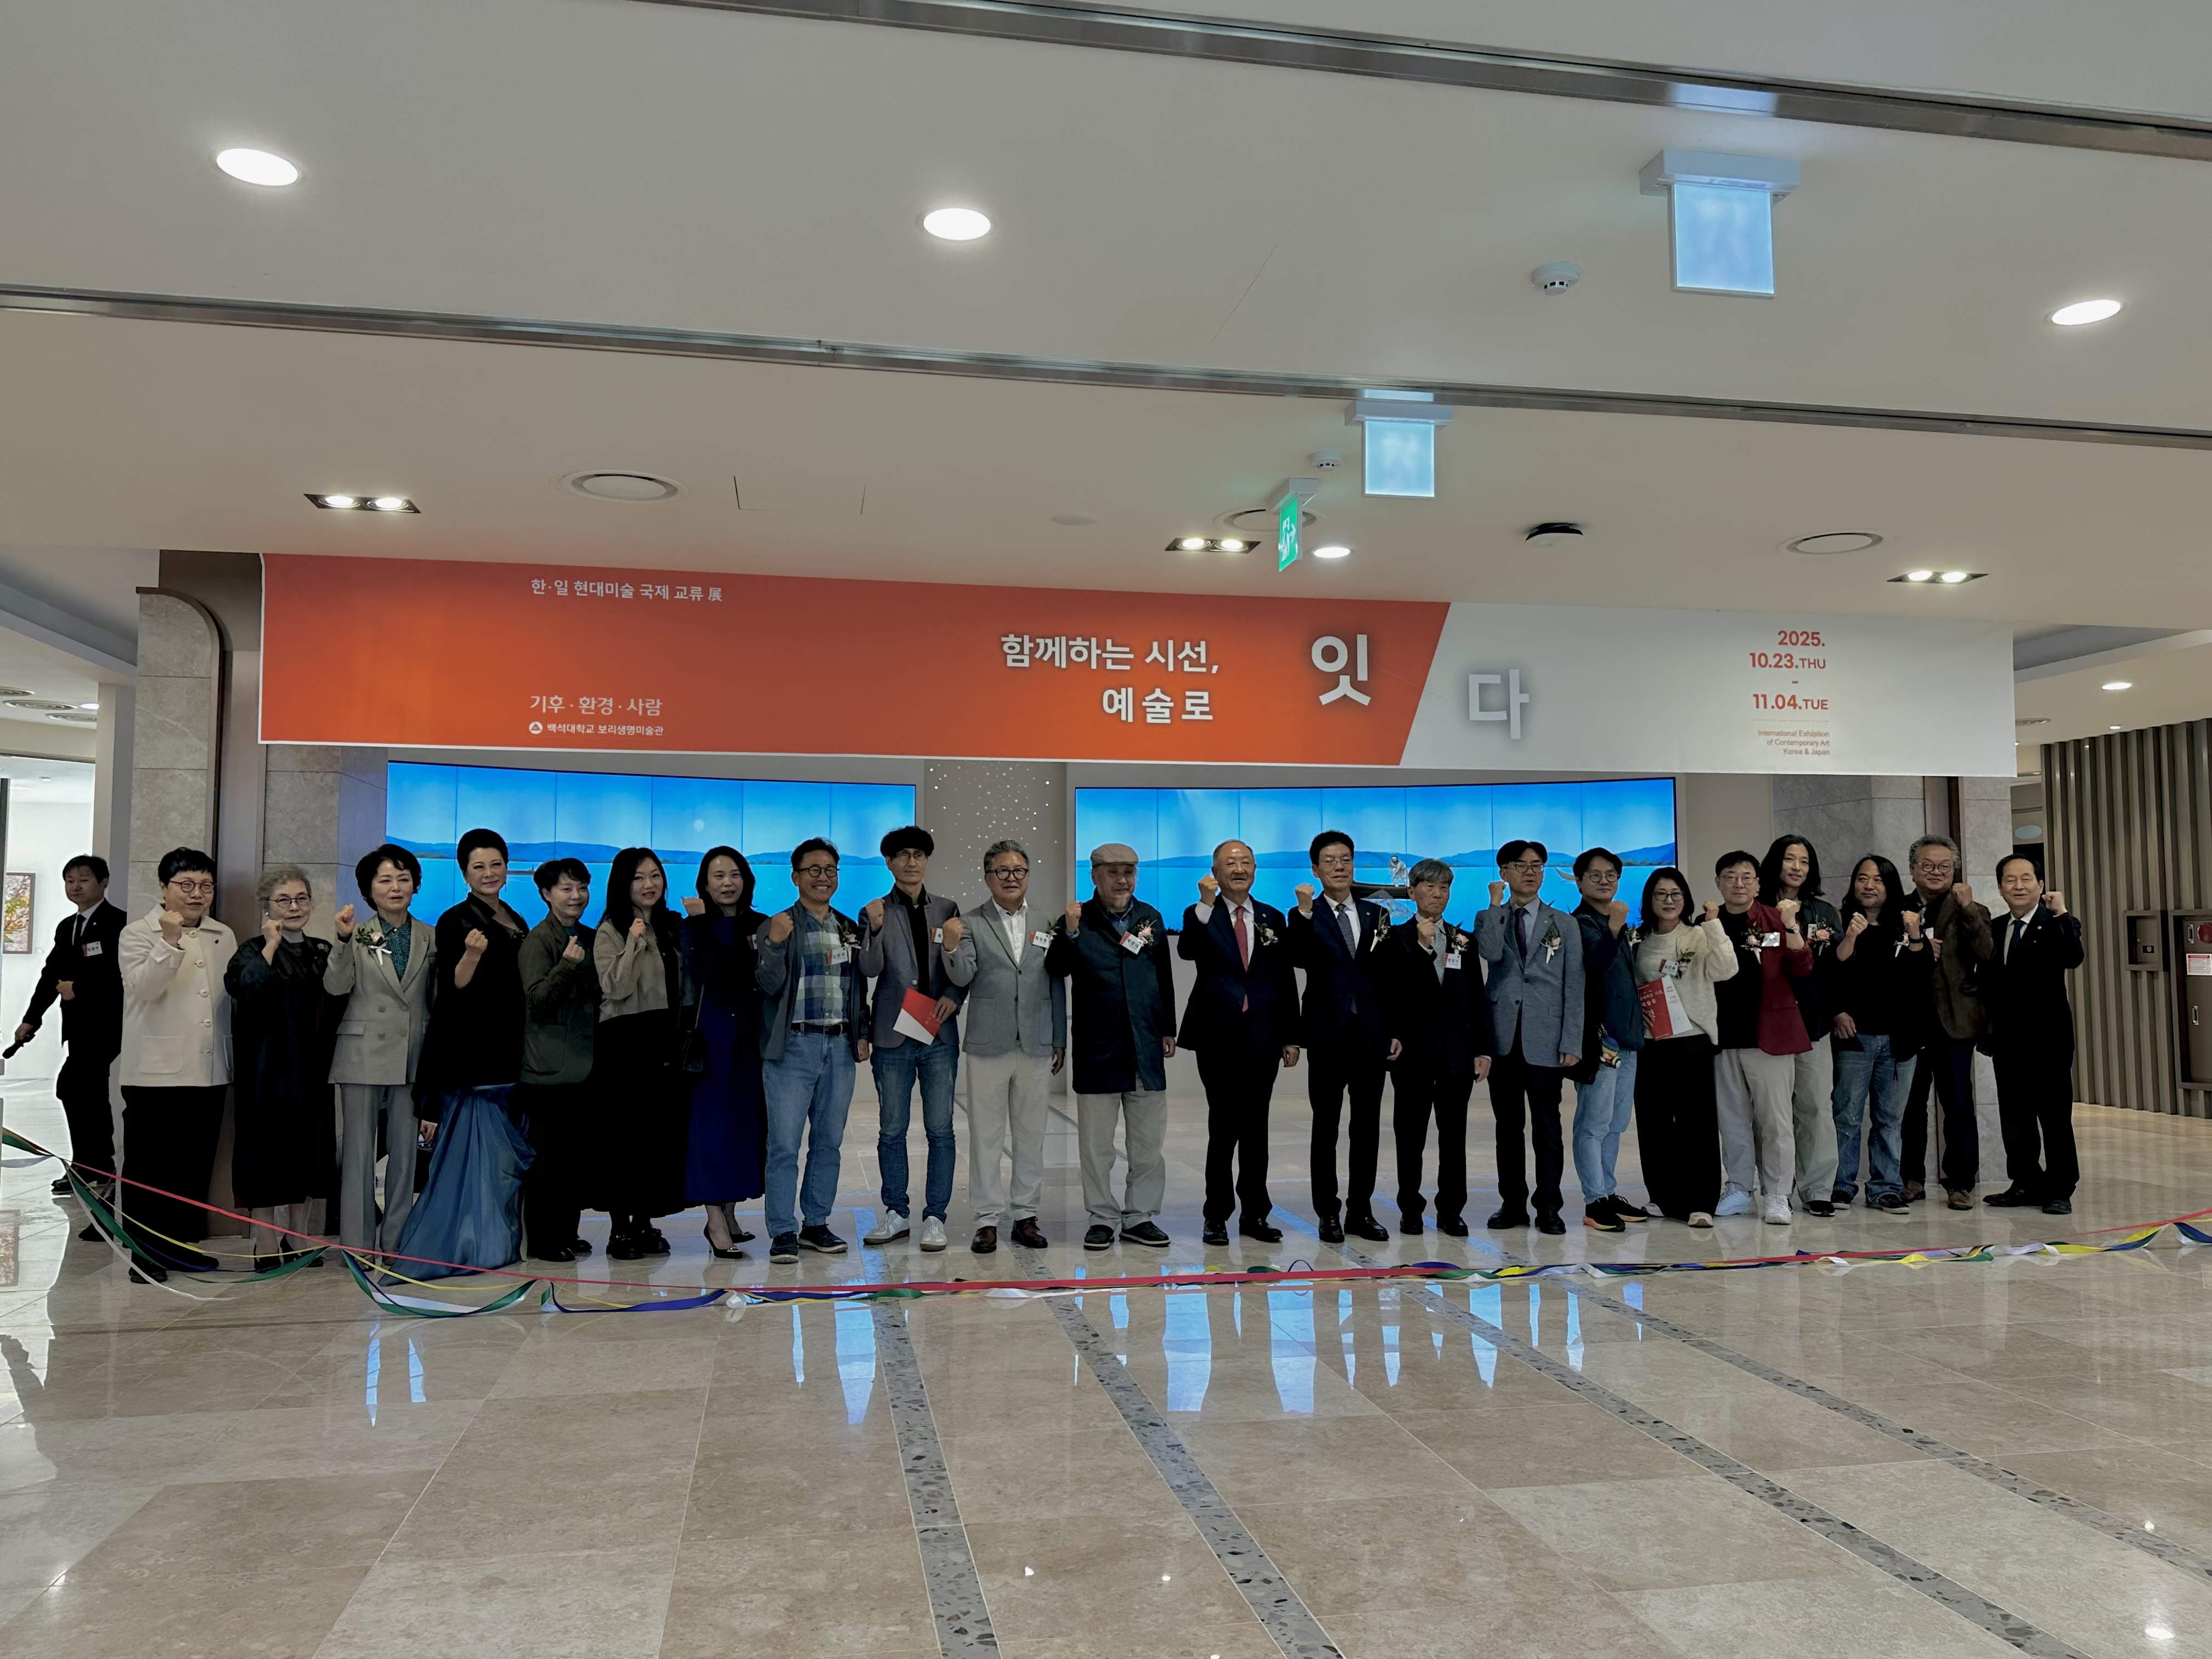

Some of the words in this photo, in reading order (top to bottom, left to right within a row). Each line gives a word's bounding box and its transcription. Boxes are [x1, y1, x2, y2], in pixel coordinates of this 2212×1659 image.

[573, 580, 635, 599] 현대미술
[639, 584, 669, 600] 국제
[674, 586, 703, 601] 교류
[708, 587, 723, 602] 展
[1778, 630, 1825, 647] 2025.
[1001, 634, 1135, 670] 함께하는
[1144, 640, 1219, 674] 시선,
[1311, 634, 1371, 706] 잇
[1467, 669, 1530, 739] 다
[530, 695, 565, 714] 기후
[579, 696, 613, 715] 환경
[626, 698, 663, 716] 사람
[547, 723, 595, 734] 백석대학교
[597, 725, 664, 736] 보리생명미술관
[1775, 739, 1819, 747] Contemporary
